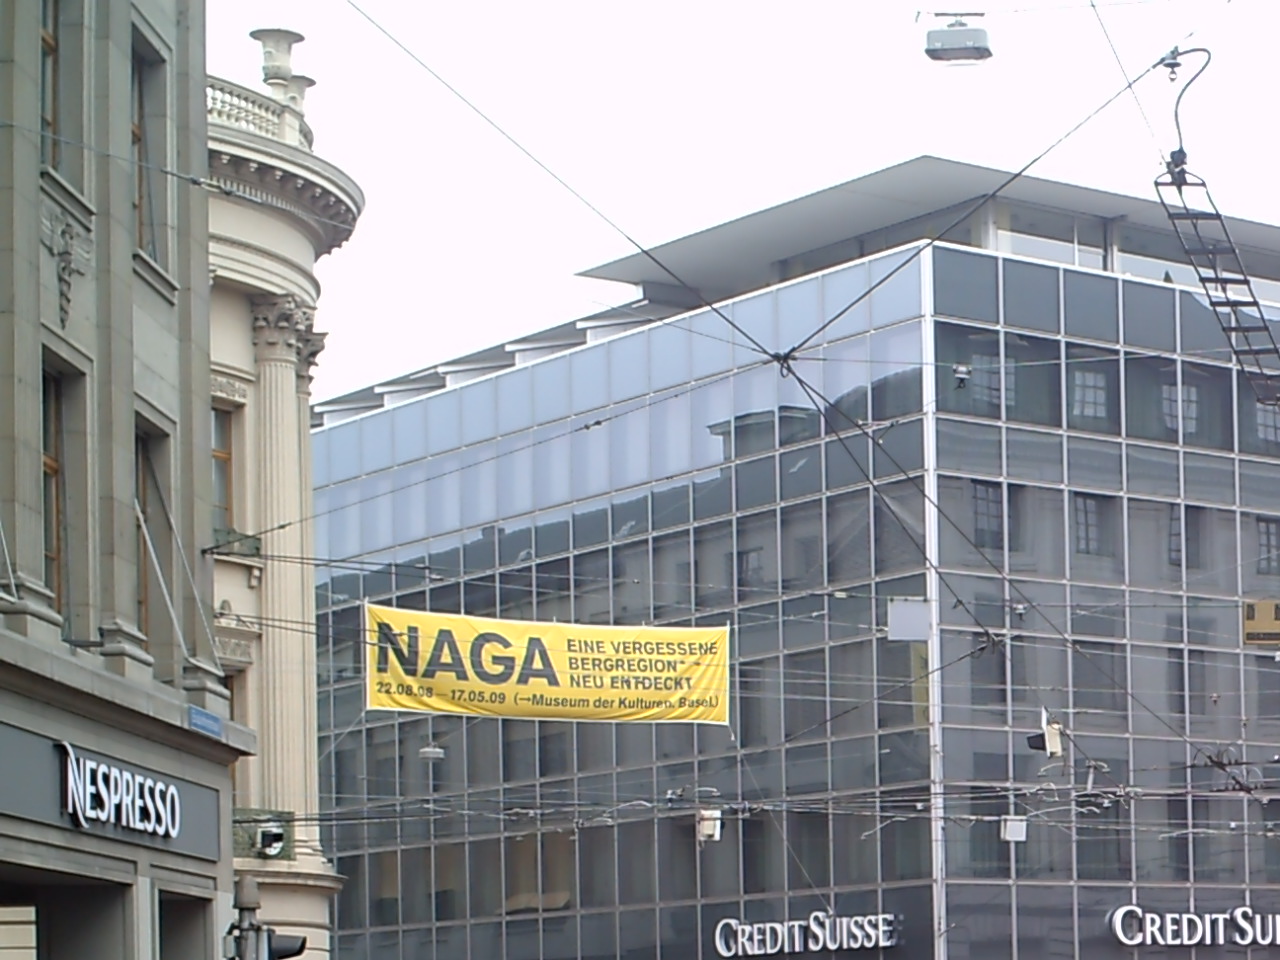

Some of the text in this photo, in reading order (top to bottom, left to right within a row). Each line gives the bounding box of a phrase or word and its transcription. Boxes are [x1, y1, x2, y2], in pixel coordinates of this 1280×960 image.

[376, 621, 561, 688] NAGA
[566, 638, 719, 656] EINE VERGESSENE
[568, 656, 678, 673] BERGREGION
[376, 682, 434, 698] 22.08.08
[450, 689, 506, 705] 17.05.09
[593, 696, 616, 709] der
[569, 674, 693, 691] NEU ENTDECKT
[62, 740, 181, 839] NESPRESSO
[714, 910, 895, 958] CREDIT SUISSE
[1111, 904, 1231, 946] CREDIT
